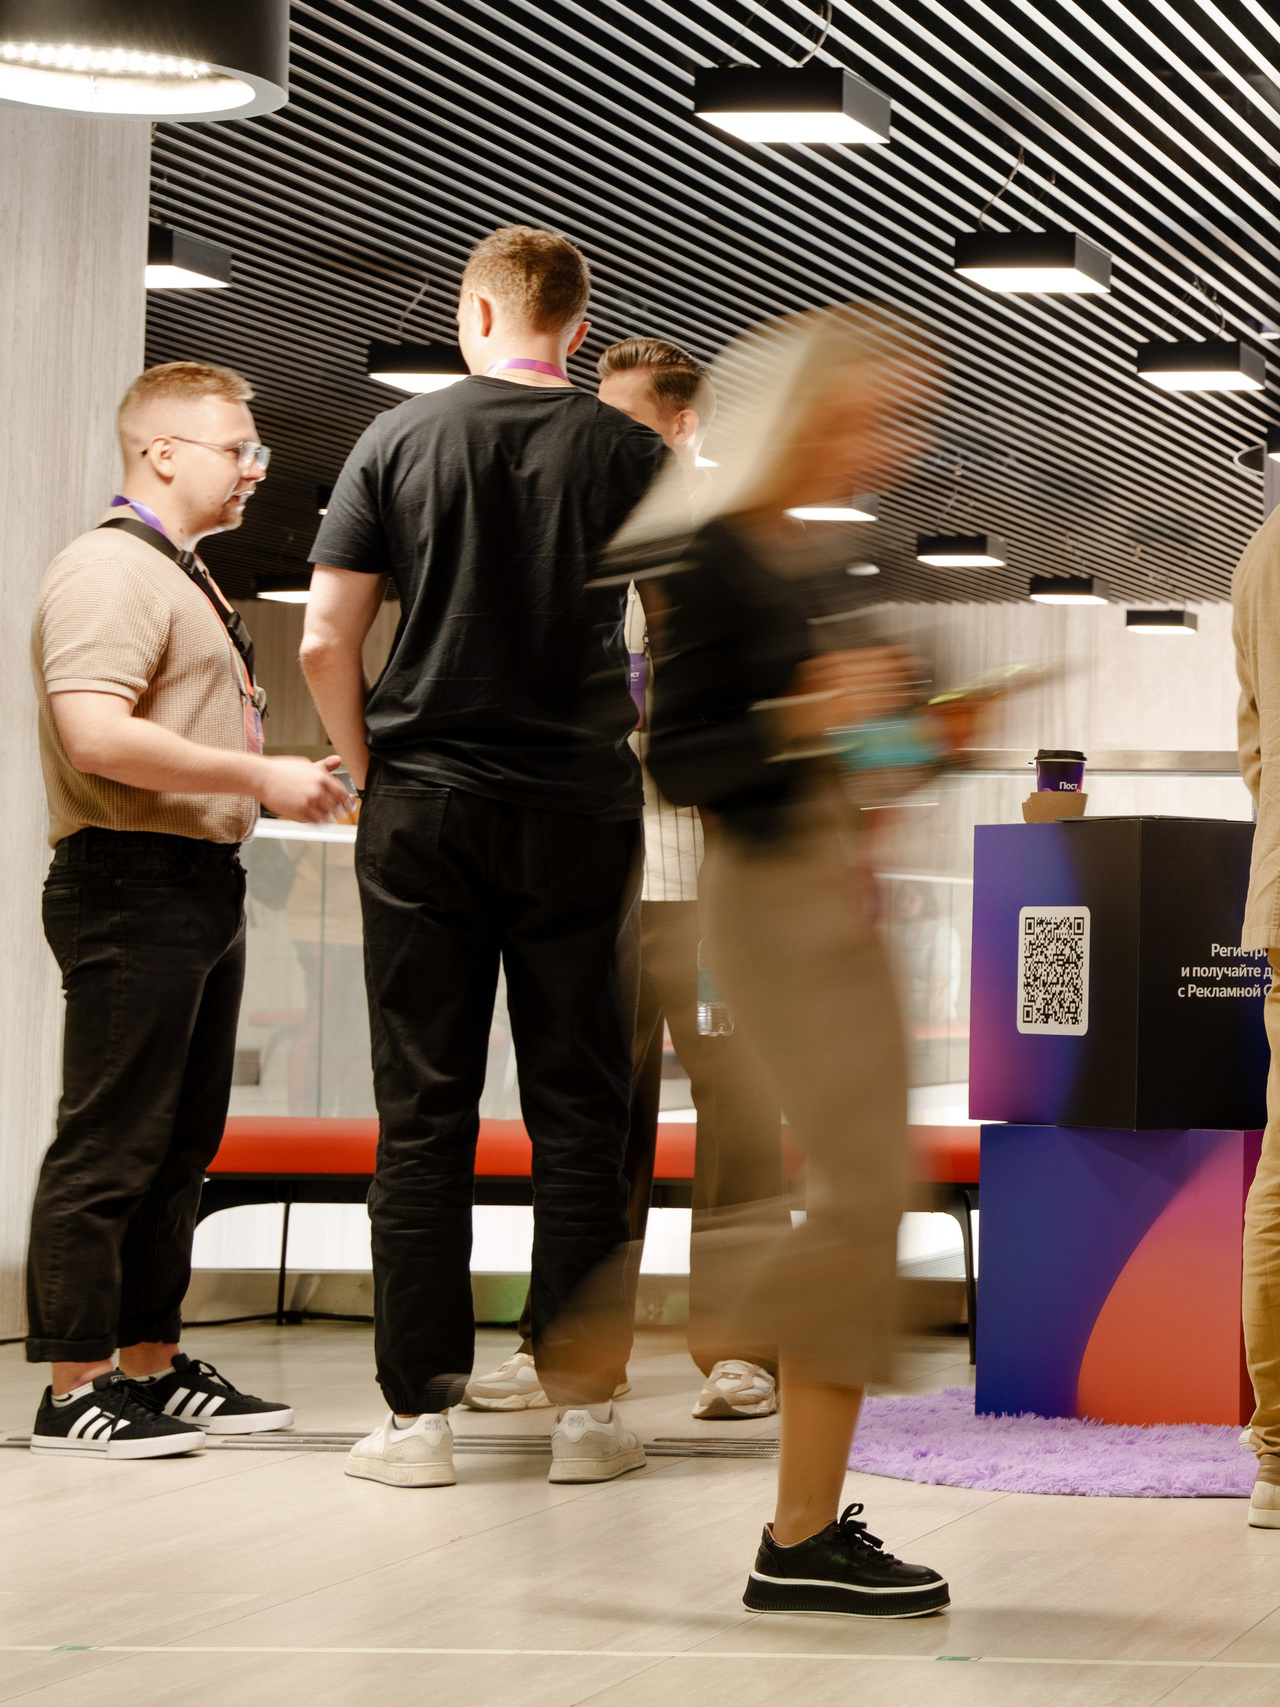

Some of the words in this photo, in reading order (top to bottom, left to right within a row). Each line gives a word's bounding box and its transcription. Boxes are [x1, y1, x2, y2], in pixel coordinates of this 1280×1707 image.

[1059, 781, 1078, 789] Пост
[1181, 966, 1189, 977] и
[1192, 964, 1261, 980] получайте
[1177, 987, 1185, 997] с
[1187, 983, 1261, 997] Рекламной
